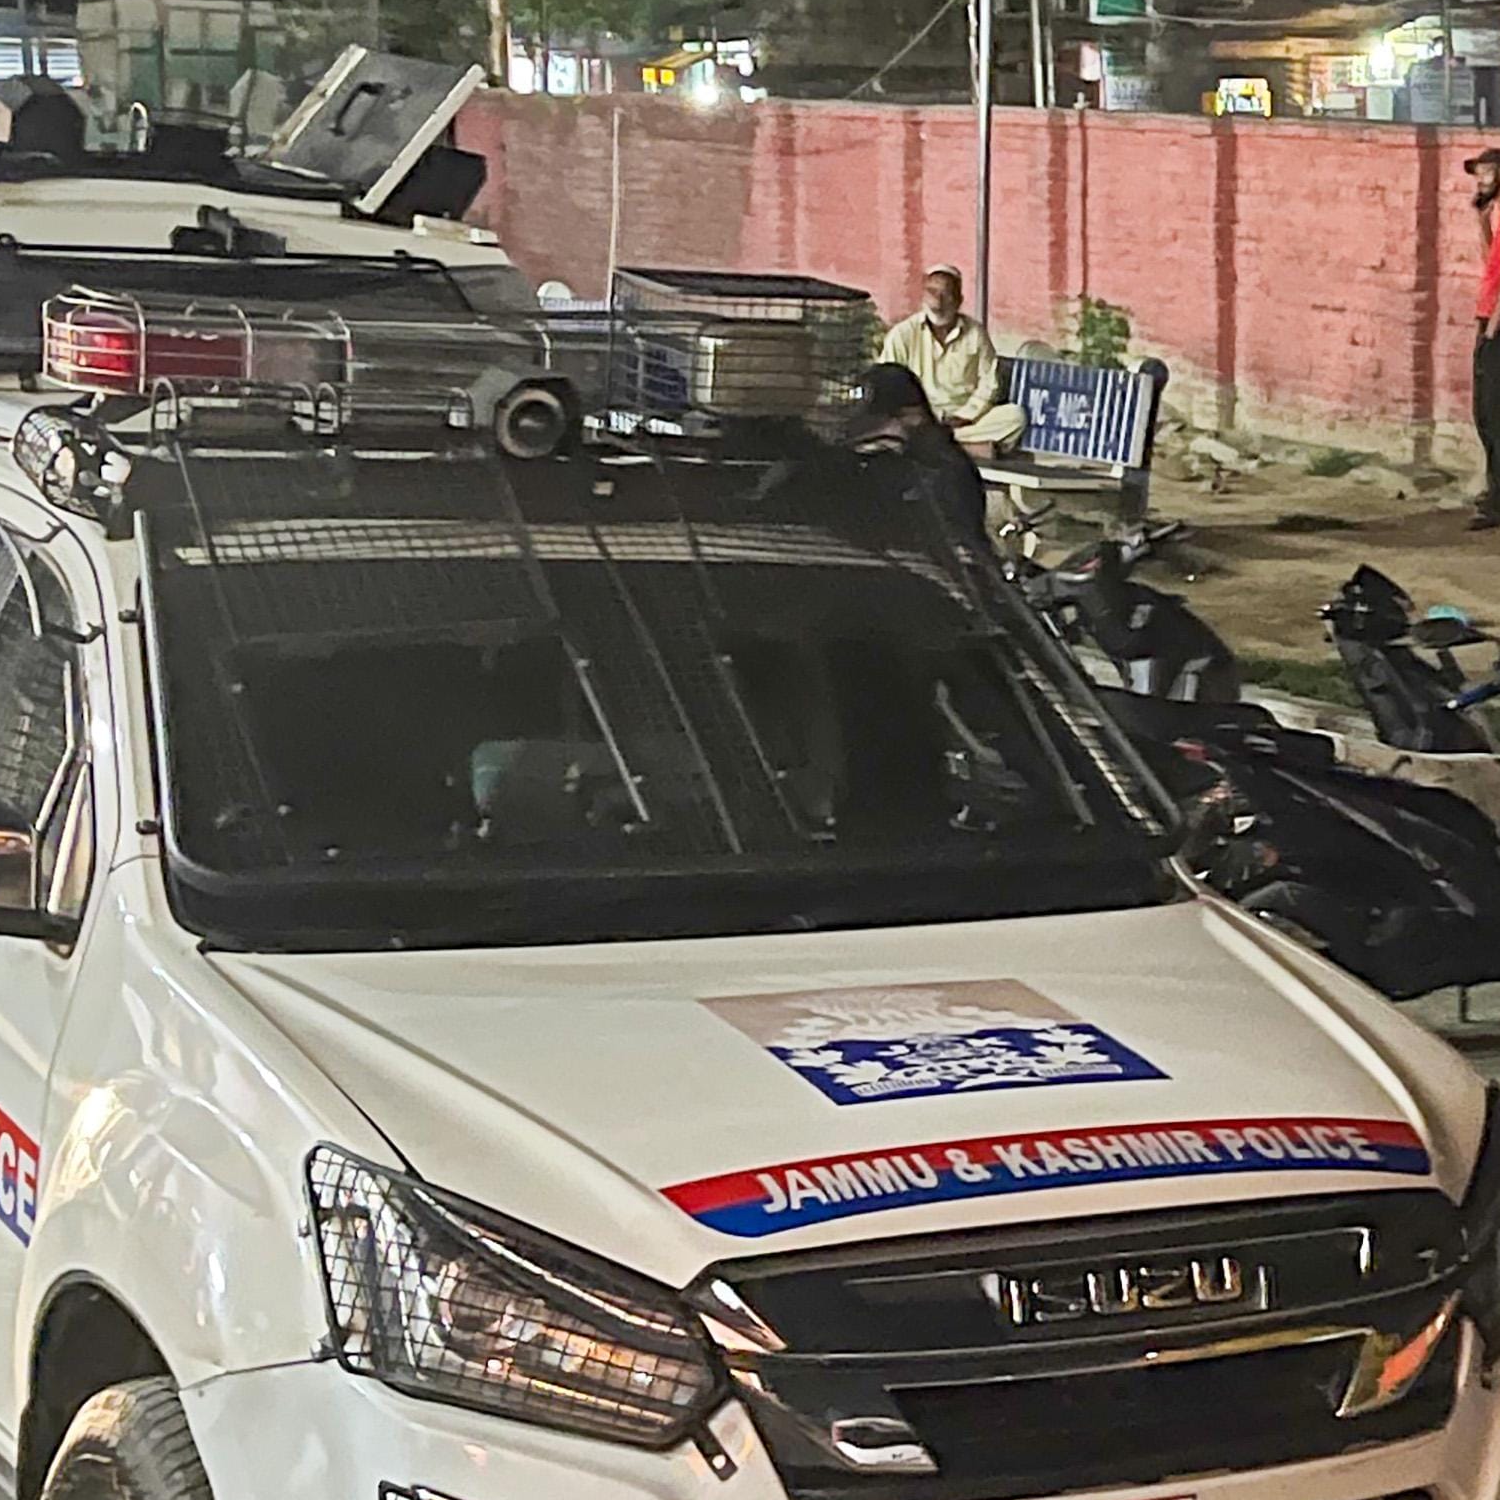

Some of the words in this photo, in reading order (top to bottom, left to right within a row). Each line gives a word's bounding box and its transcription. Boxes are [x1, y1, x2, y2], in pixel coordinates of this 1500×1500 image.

[762, 1157, 936, 1214] JAMMU
[946, 1146, 992, 1184] &
[992, 1130, 1216, 1179] KASHMIR
[1220, 1125, 1381, 1162] POLICE
[1008, 1256, 1242, 1326] ISUZU
